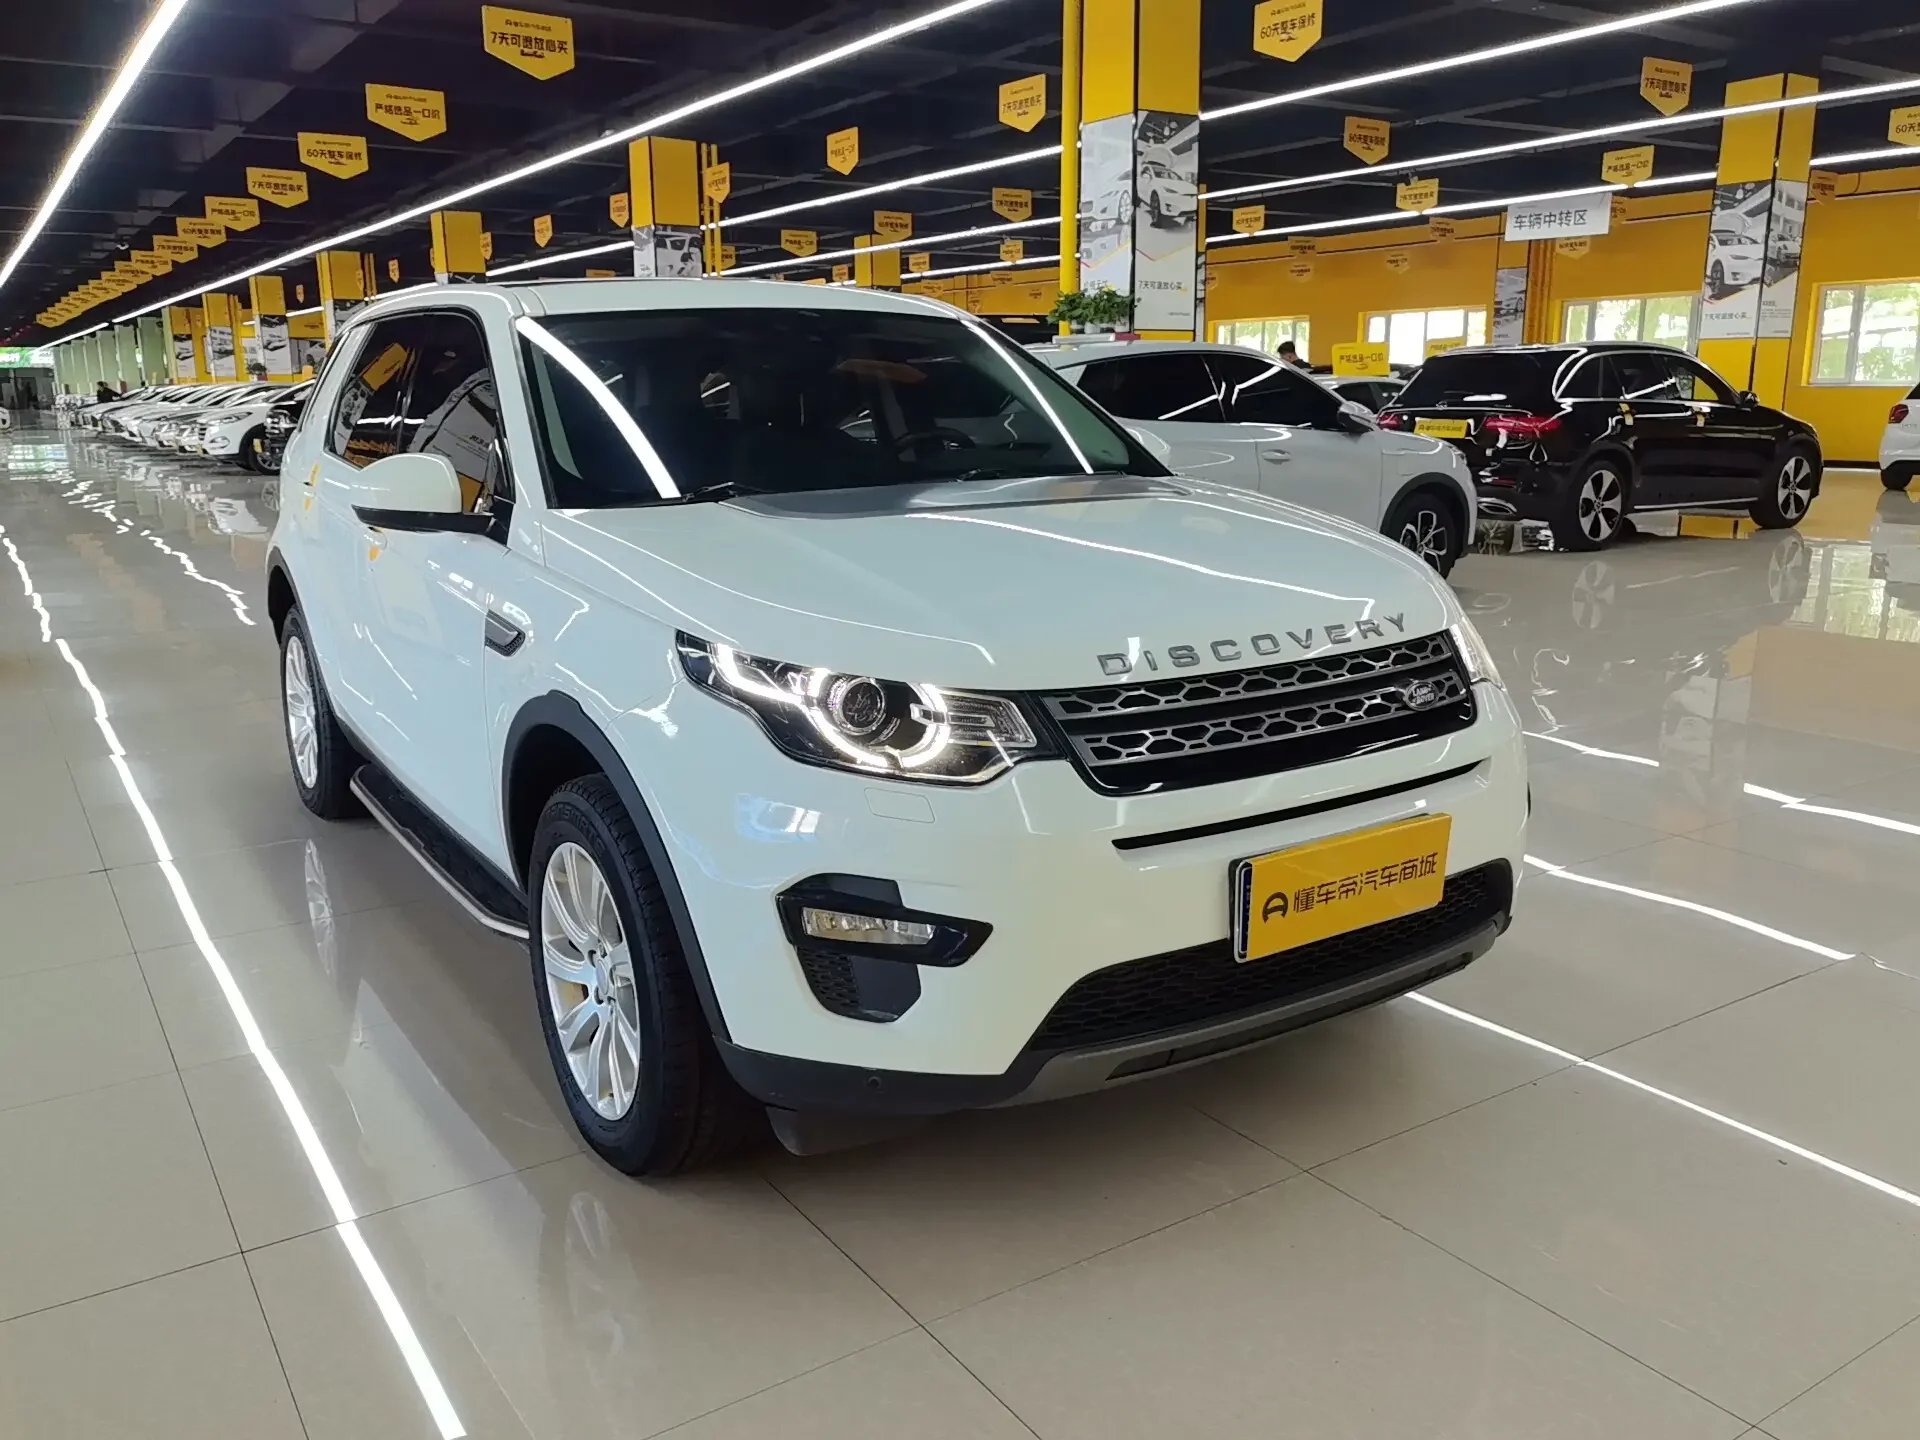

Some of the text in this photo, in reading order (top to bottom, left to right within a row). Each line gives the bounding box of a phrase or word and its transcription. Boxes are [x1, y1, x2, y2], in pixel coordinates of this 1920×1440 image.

[1260, 12, 1317, 40] 60天整车保修
[490, 31, 569, 55] 7天可退放心买
[1513, 209, 1588, 231] 车辆中转区
[1096, 612, 1405, 676] DISCOVERY
[1293, 852, 1438, 913] 懂车帝汽车商城
